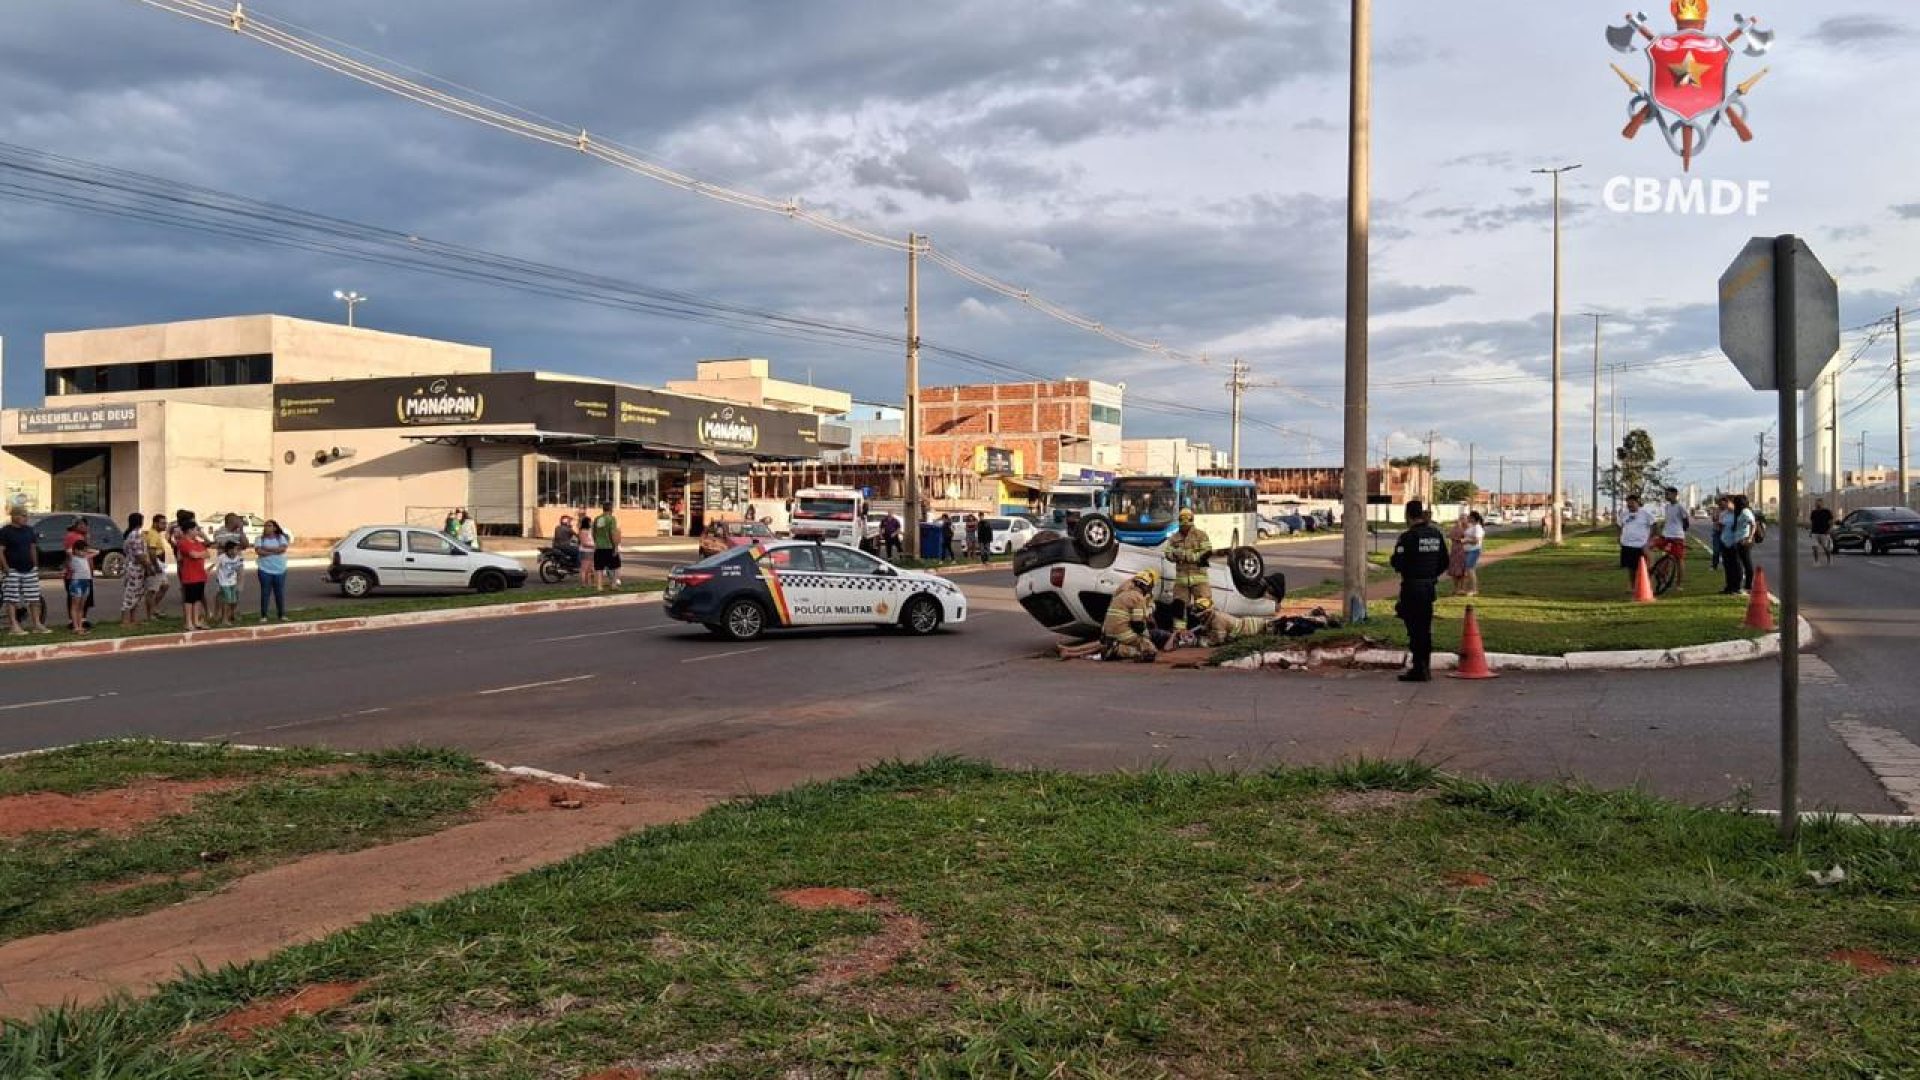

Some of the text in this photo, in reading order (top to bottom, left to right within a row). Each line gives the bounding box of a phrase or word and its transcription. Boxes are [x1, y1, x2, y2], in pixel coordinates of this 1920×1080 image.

[406, 393, 475, 416] MANÁPAN
[29, 408, 135, 424] ASSEMBLEIA DE DEUS
[834, 605, 873, 614] MILITAR
